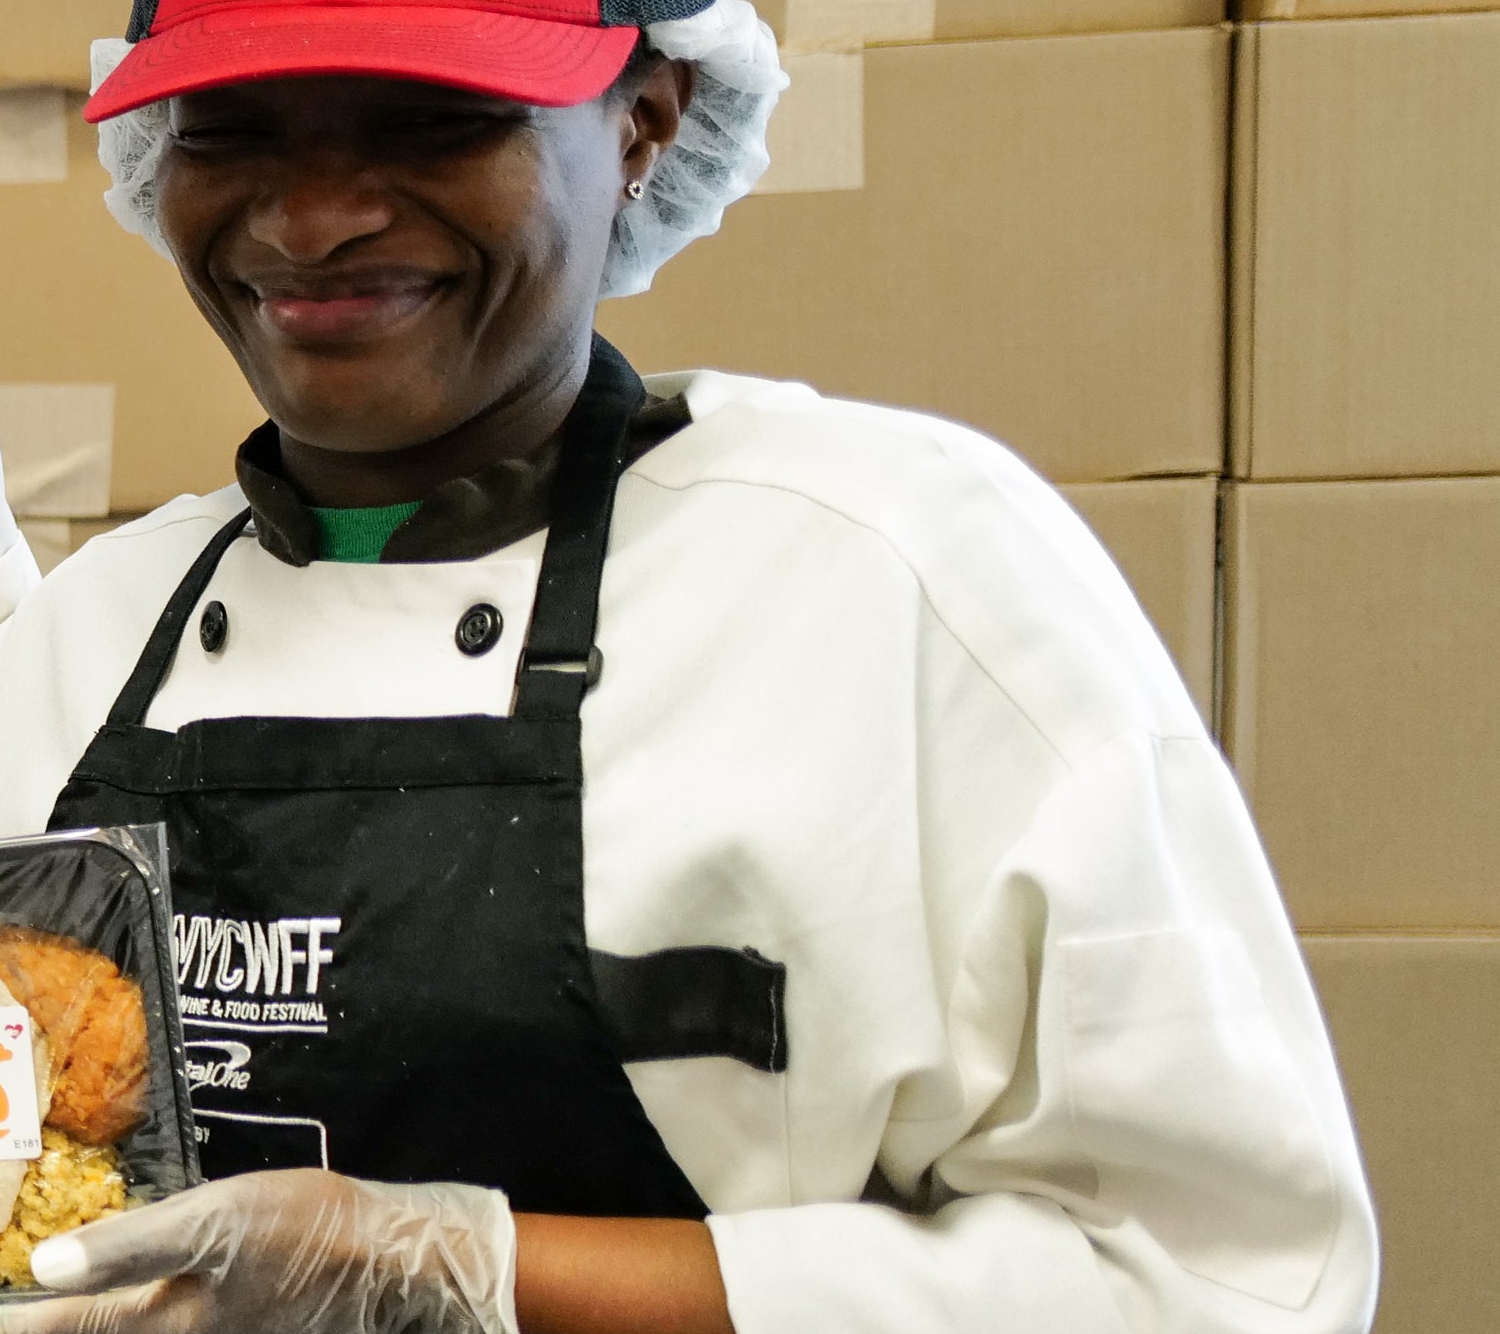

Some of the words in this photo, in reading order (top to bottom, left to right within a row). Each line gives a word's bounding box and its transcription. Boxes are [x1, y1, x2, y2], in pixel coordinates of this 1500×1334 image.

[211, 1000, 223, 1018] &
[224, 1001, 260, 1021] FOOD
[262, 1002, 328, 1022] FESTIVAL
[13, 1138, 40, 1149] E181
